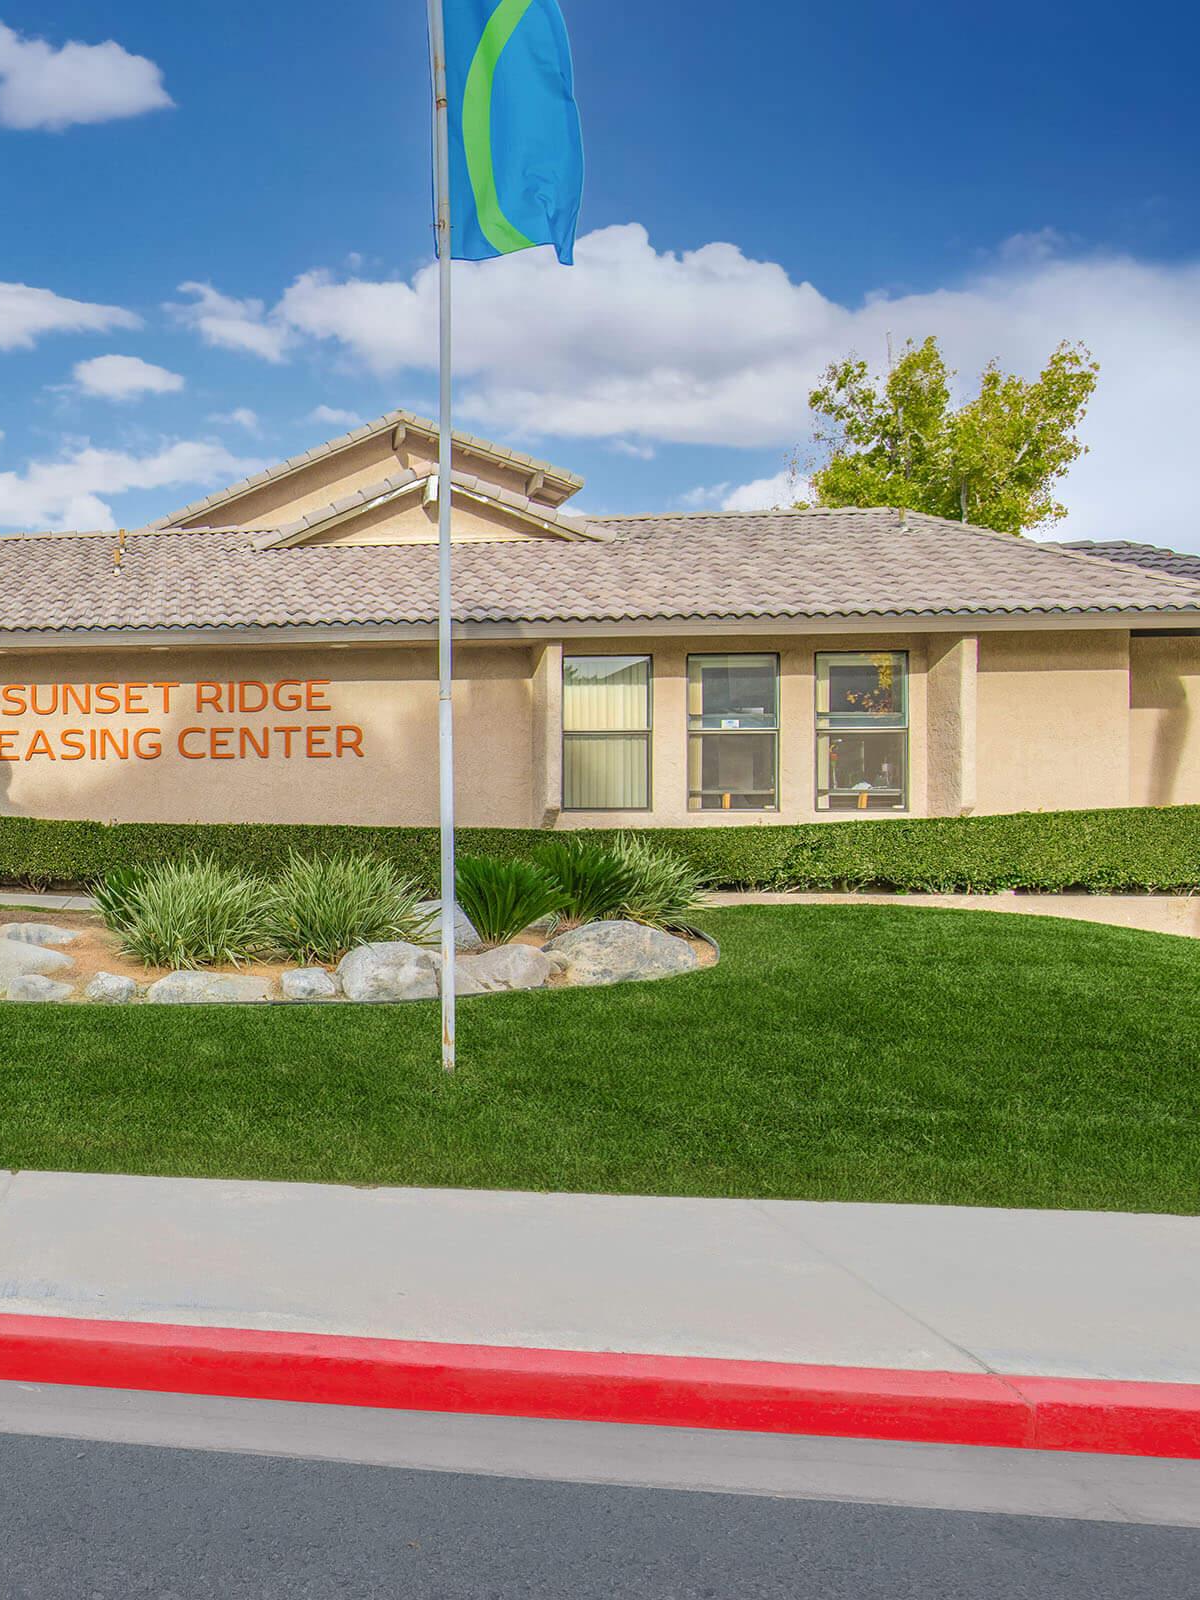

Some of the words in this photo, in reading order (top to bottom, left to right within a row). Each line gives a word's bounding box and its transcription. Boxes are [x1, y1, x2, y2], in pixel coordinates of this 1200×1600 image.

[1, 682, 180, 716] SUNSET
[195, 679, 332, 713] RIDGE
[177, 725, 365, 759] CENTER
